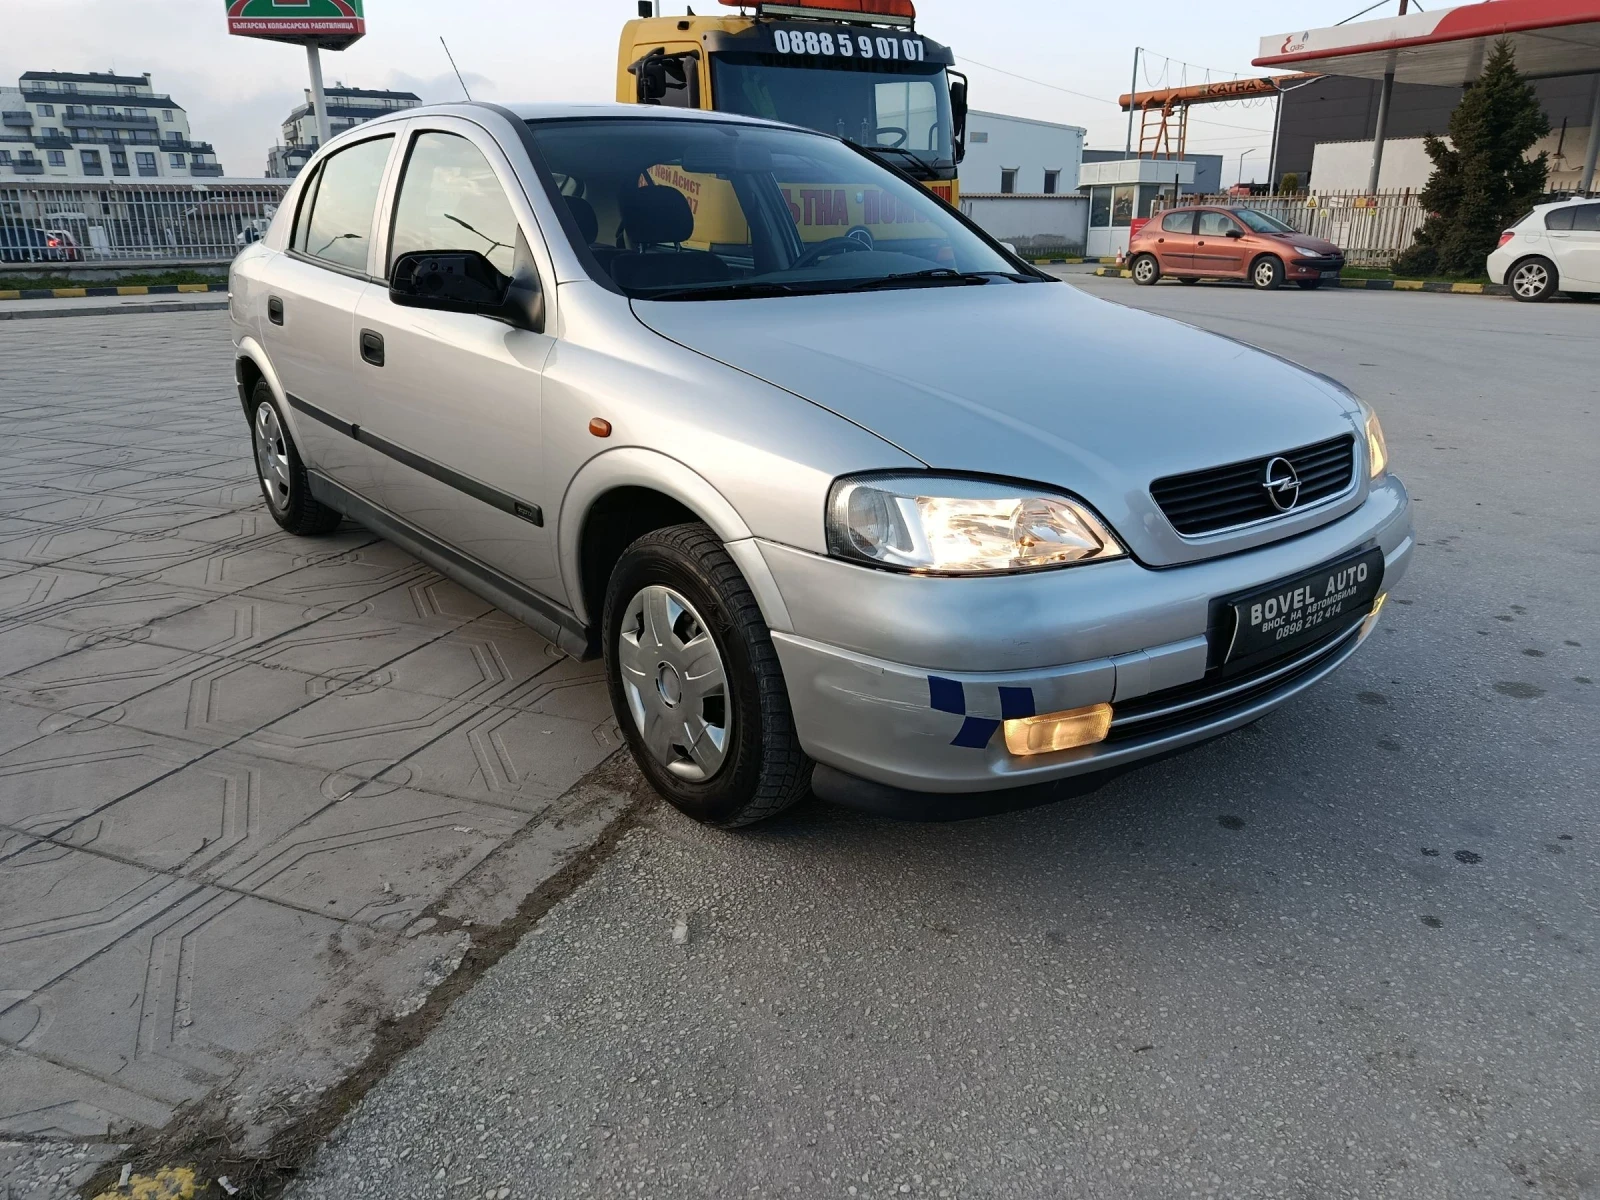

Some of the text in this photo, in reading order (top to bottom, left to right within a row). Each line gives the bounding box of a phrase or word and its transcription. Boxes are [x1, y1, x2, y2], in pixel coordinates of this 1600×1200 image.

[774, 29, 835, 55] 0888
[1250, 562, 1368, 626] BOVEL AUTO
[1262, 585, 1357, 633] ВНОС НА АВТОМОБИЛИ
[1275, 601, 1342, 641] 0898 212 414
